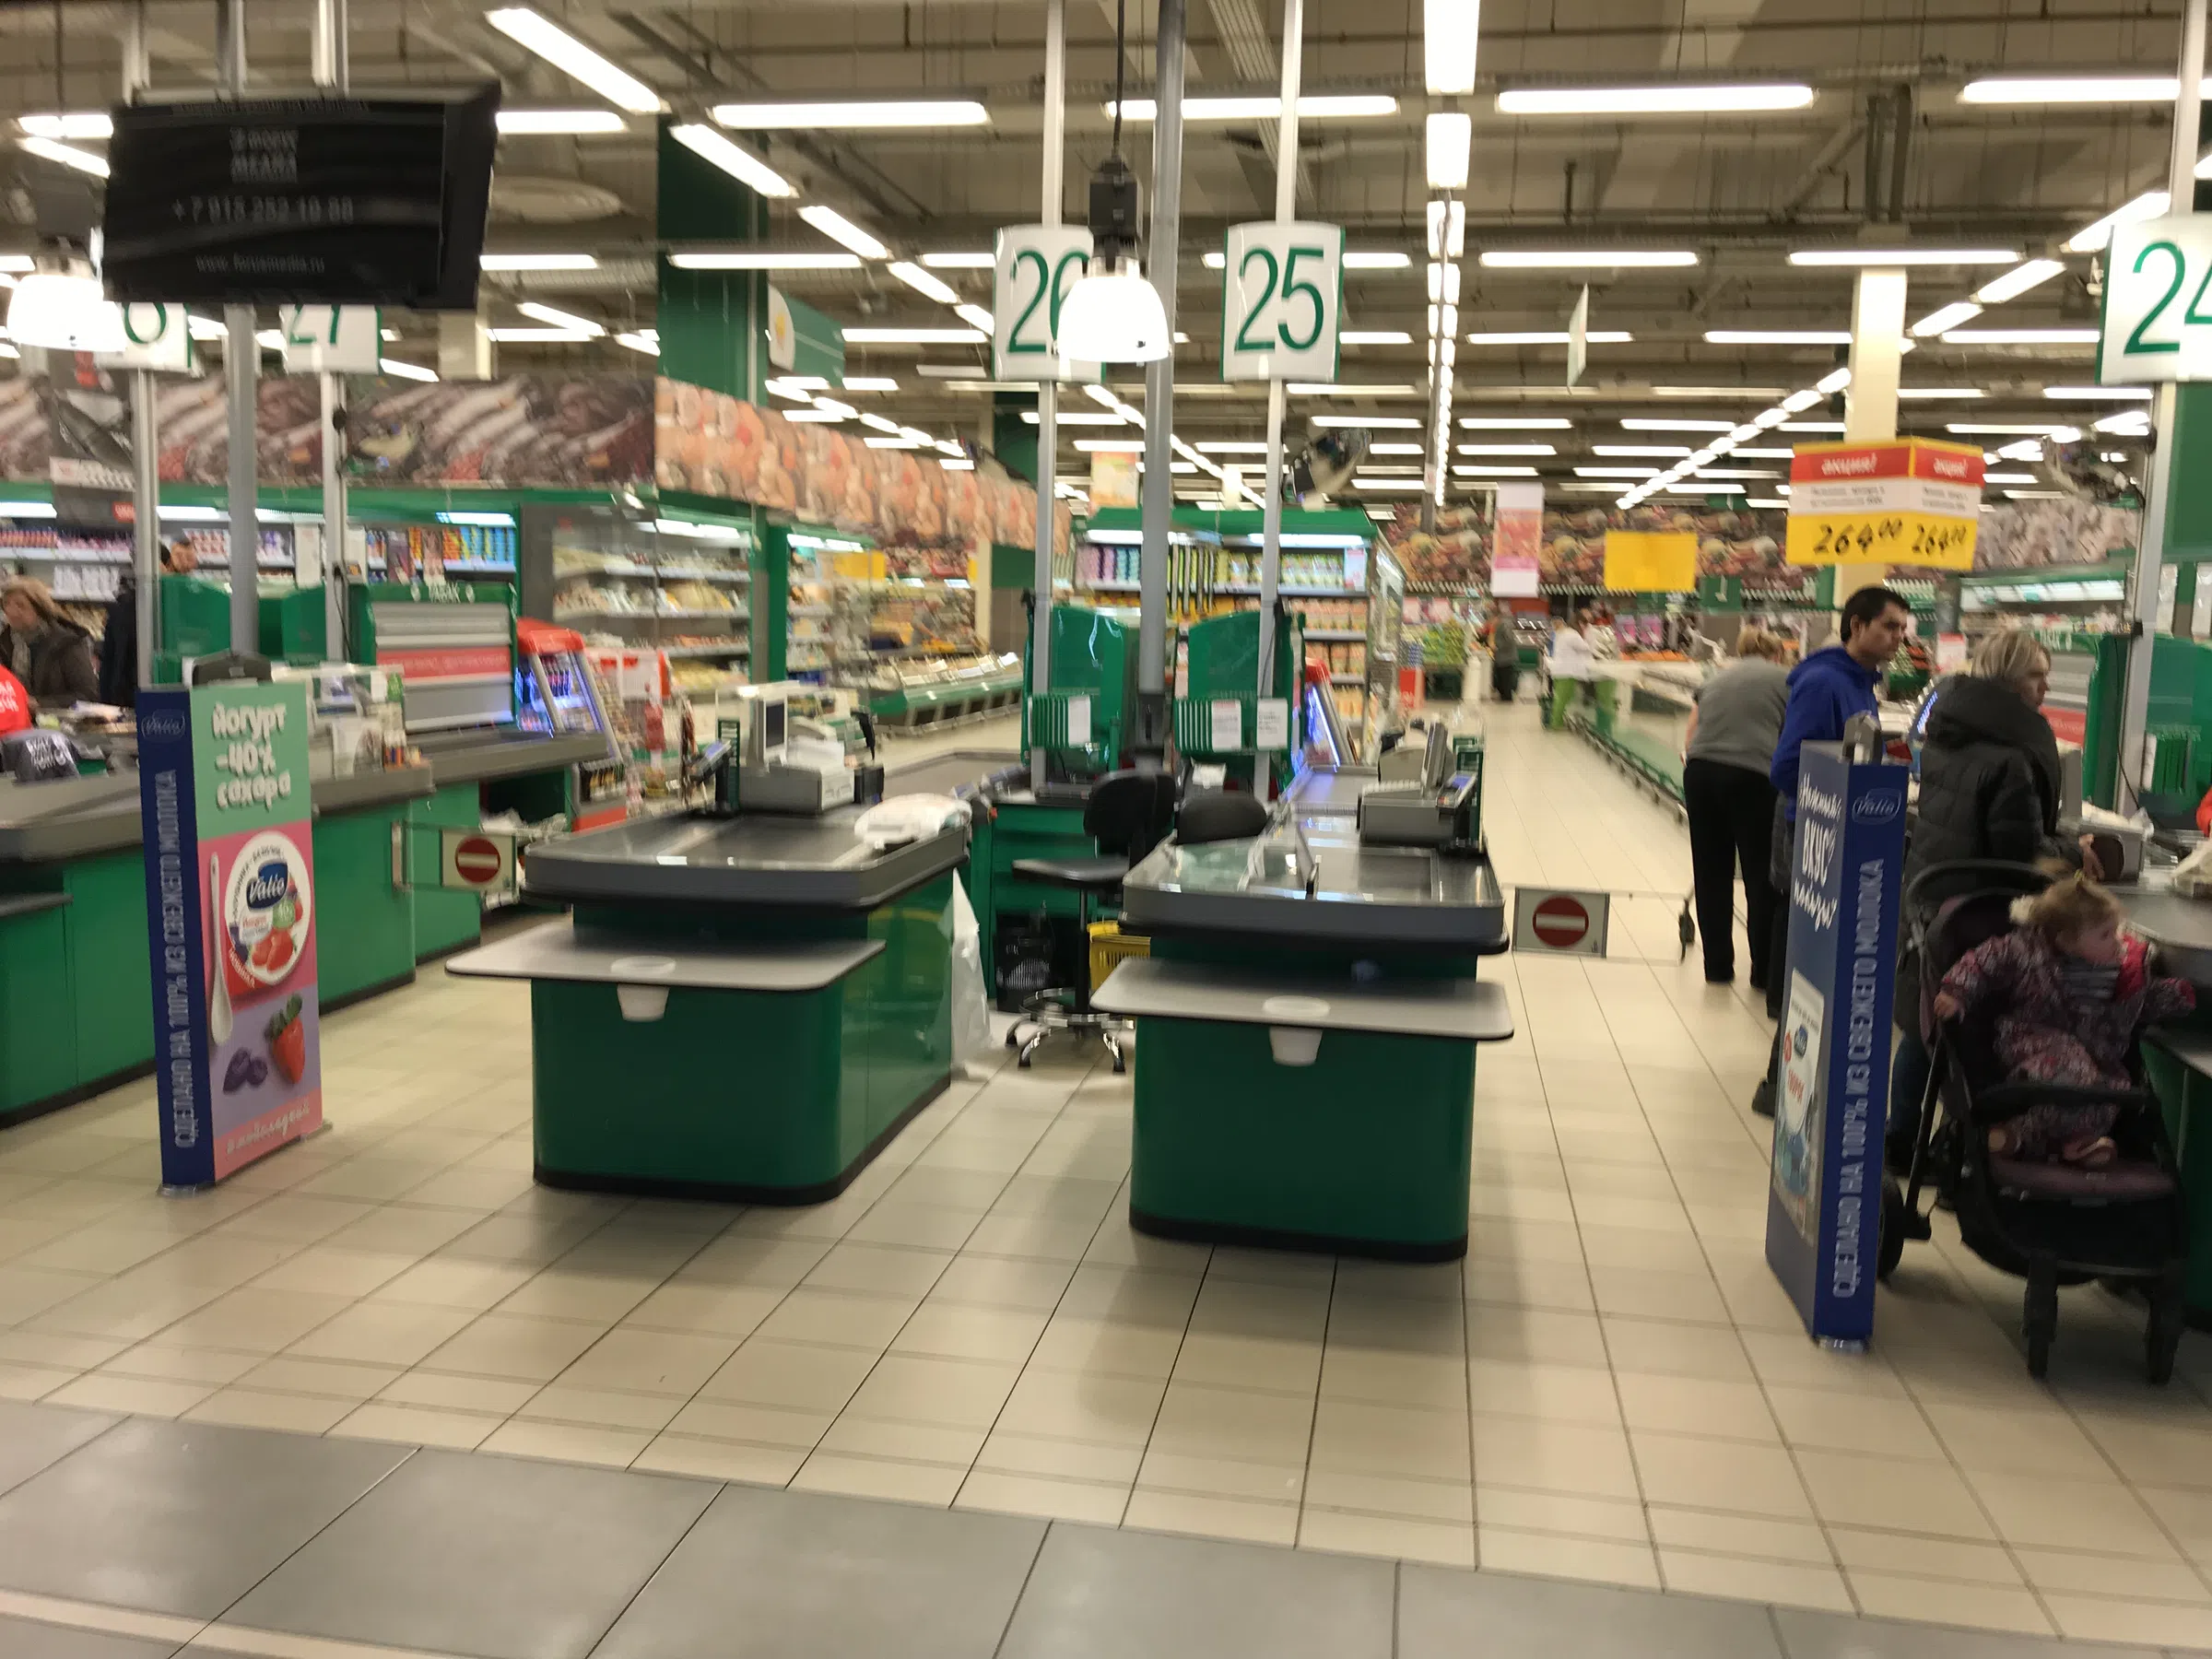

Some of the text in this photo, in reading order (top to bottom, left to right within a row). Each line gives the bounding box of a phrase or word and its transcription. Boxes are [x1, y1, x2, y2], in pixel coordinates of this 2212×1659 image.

[1235, 247, 1324, 351] 25
[249, 874, 285, 901] Valio
[1833, 859, 1884, 1299] СДЕЛАНО НА 100% ИЗ СВЕЖЕГО МОЛОКА
